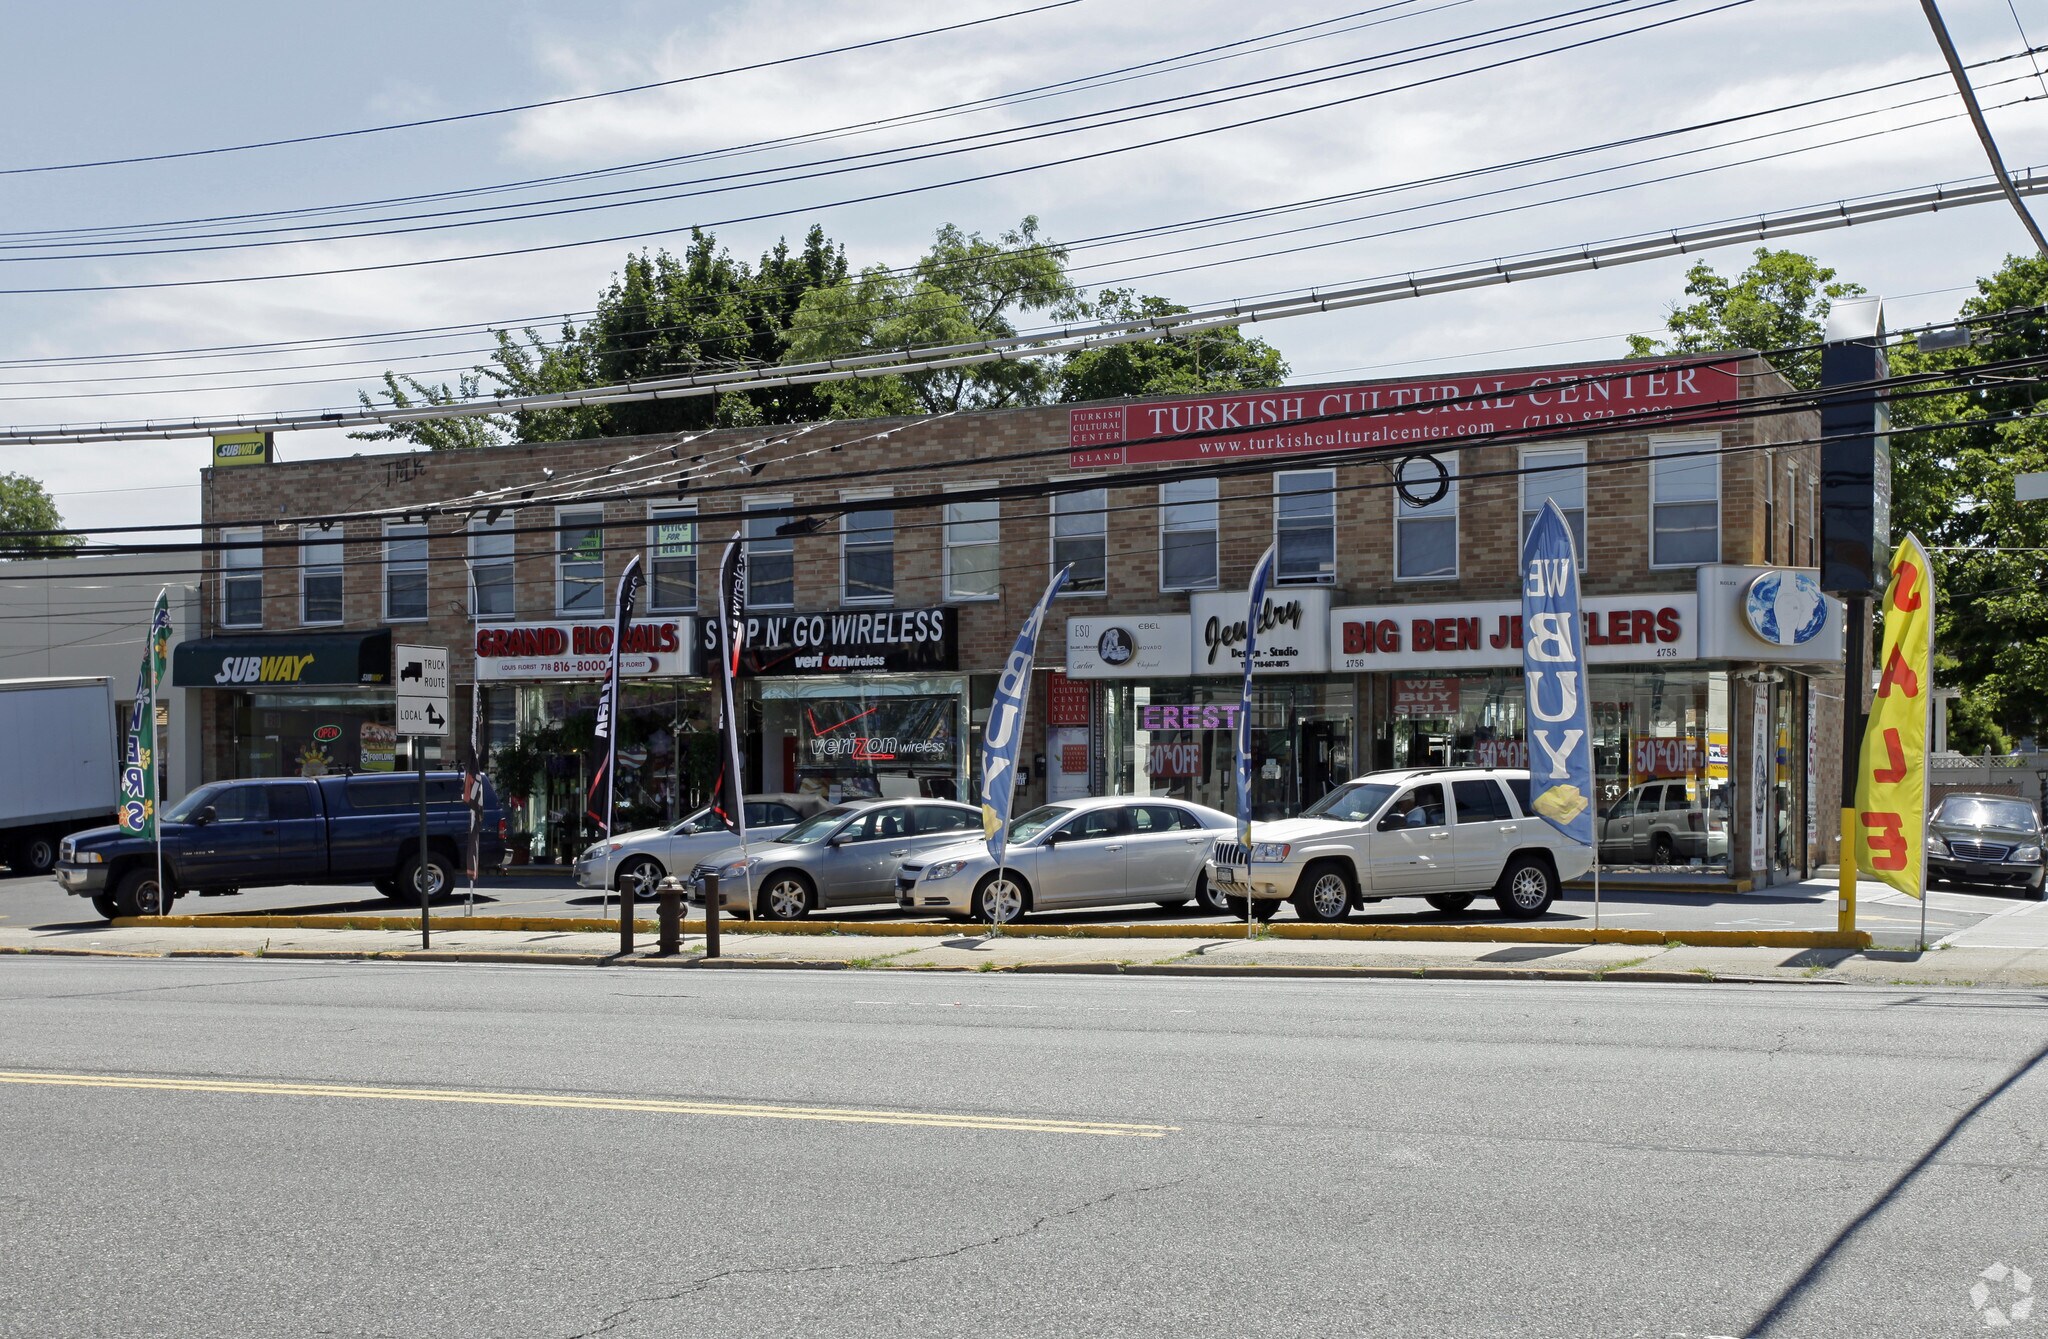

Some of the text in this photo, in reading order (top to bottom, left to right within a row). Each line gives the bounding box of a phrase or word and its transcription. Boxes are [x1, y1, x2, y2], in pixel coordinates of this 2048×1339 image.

[1148, 368, 1701, 434] TURKISH CULTURAL CENTER
[1073, 411, 1121, 421] TURKISH
[1073, 422, 1120, 432] CULTURAL
[1073, 432, 1120, 442] CENTER
[1199, 421, 1494, 453] www.turkishculturalcenter.com
[217, 442, 264, 457] SUBWAY
[1073, 452, 1120, 463] ISLAND
[666, 533, 680, 541] FOR
[704, 610, 944, 650] SP N' GO WIRELESS
[1138, 622, 1161, 630] EBEL
[1343, 619, 1400, 655] BIG
[1411, 617, 1480, 652] BEN
[476, 627, 568, 658] GRAND
[1231, 648, 1261, 659] Desn
[1269, 646, 1299, 657] Studio
[1656, 648, 1677, 658] 1758
[424, 659, 446, 670] TRUCK
[540, 663, 552, 671] 718
[553, 660, 606, 672] 816-8000
[795, 652, 885, 670] verizon wireless
[1072, 660, 1095, 670] Cartier
[1345, 659, 1365, 669] 1756
[214, 652, 315, 685] SUBWAY
[361, 673, 384, 683] SUBWAY
[424, 677, 446, 688] ROUTE
[1404, 679, 1446, 690] WE
[1399, 691, 1452, 702] BUY
[400, 709, 423, 721] LOCAL
[1393, 704, 1457, 715] SELL
[1053, 713, 1087, 721] ISLAN
[1143, 705, 1240, 729] EREST
[317, 727, 338, 739] OPEN
[811, 733, 946, 760] verizon wireless
